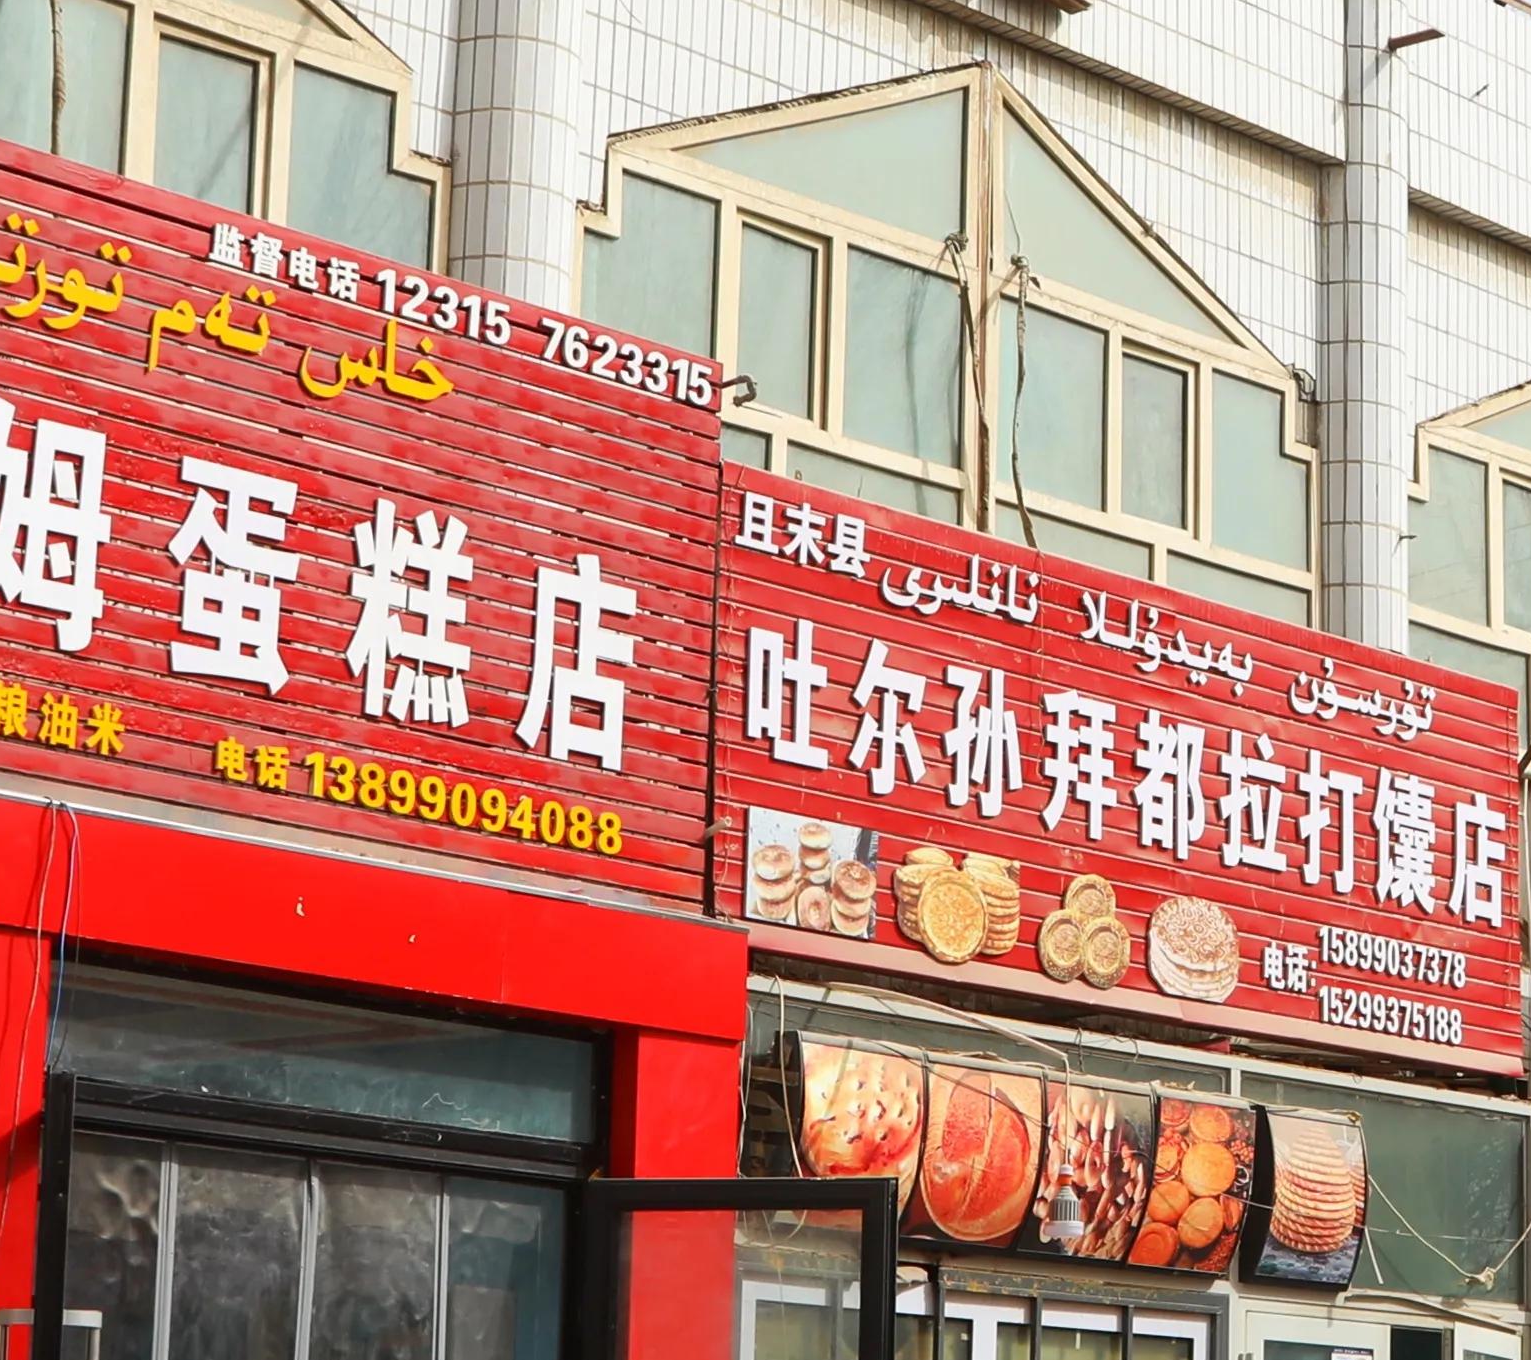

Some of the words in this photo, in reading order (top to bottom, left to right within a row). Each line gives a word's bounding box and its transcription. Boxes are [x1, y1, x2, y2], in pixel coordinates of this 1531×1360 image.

[207, 222, 362, 305] 监督电话
[375, 268, 512, 348] 12315
[538, 317, 714, 407] 7623315
[734, 492, 872, 581] 且末县
[214, 737, 290, 793] 电话
[304, 751, 626, 857] 13899094088
[746, 619, 1508, 929] 吐尔孙拜都拉打馕店
[1317, 926, 1469, 991] 15899037378
[1317, 984, 1465, 1048] 15299375188
